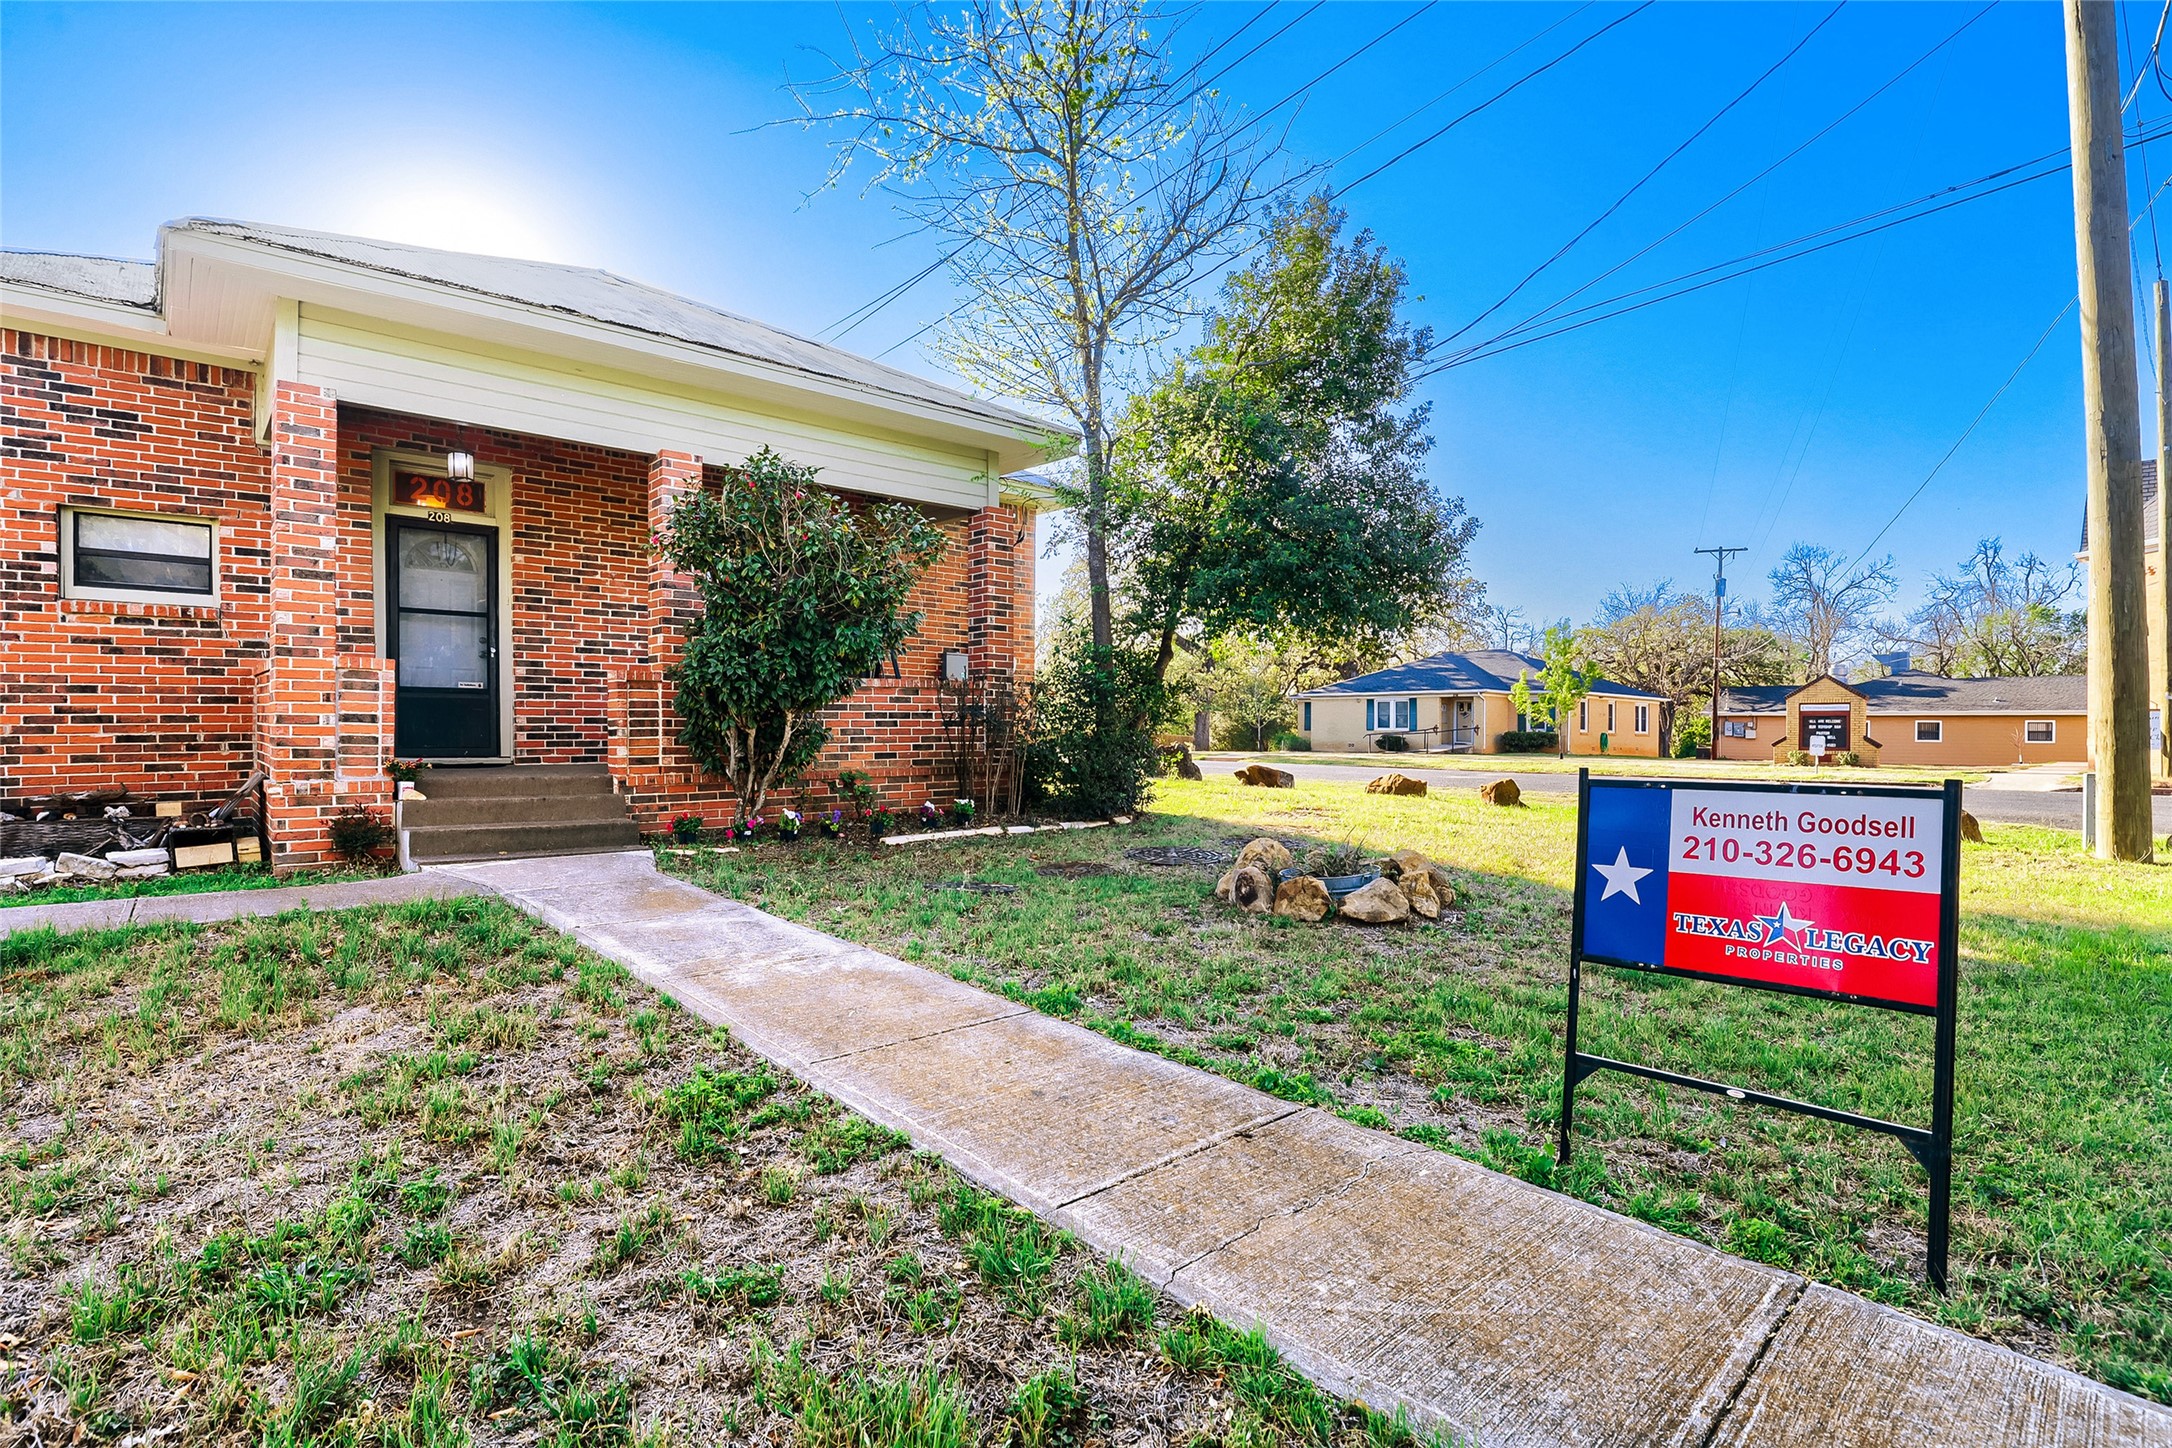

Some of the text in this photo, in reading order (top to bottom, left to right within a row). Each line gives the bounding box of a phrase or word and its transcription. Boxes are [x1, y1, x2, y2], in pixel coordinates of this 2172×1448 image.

[409, 476, 474, 507] 208
[428, 512, 451, 523] 208
[1692, 806, 1915, 839] Kenneth Goodsell
[1682, 835, 1926, 879] 210-326-6943
[1674, 912, 1934, 964] TEXAS LEGACY
[1725, 944, 1844, 971] PROPERTIES
